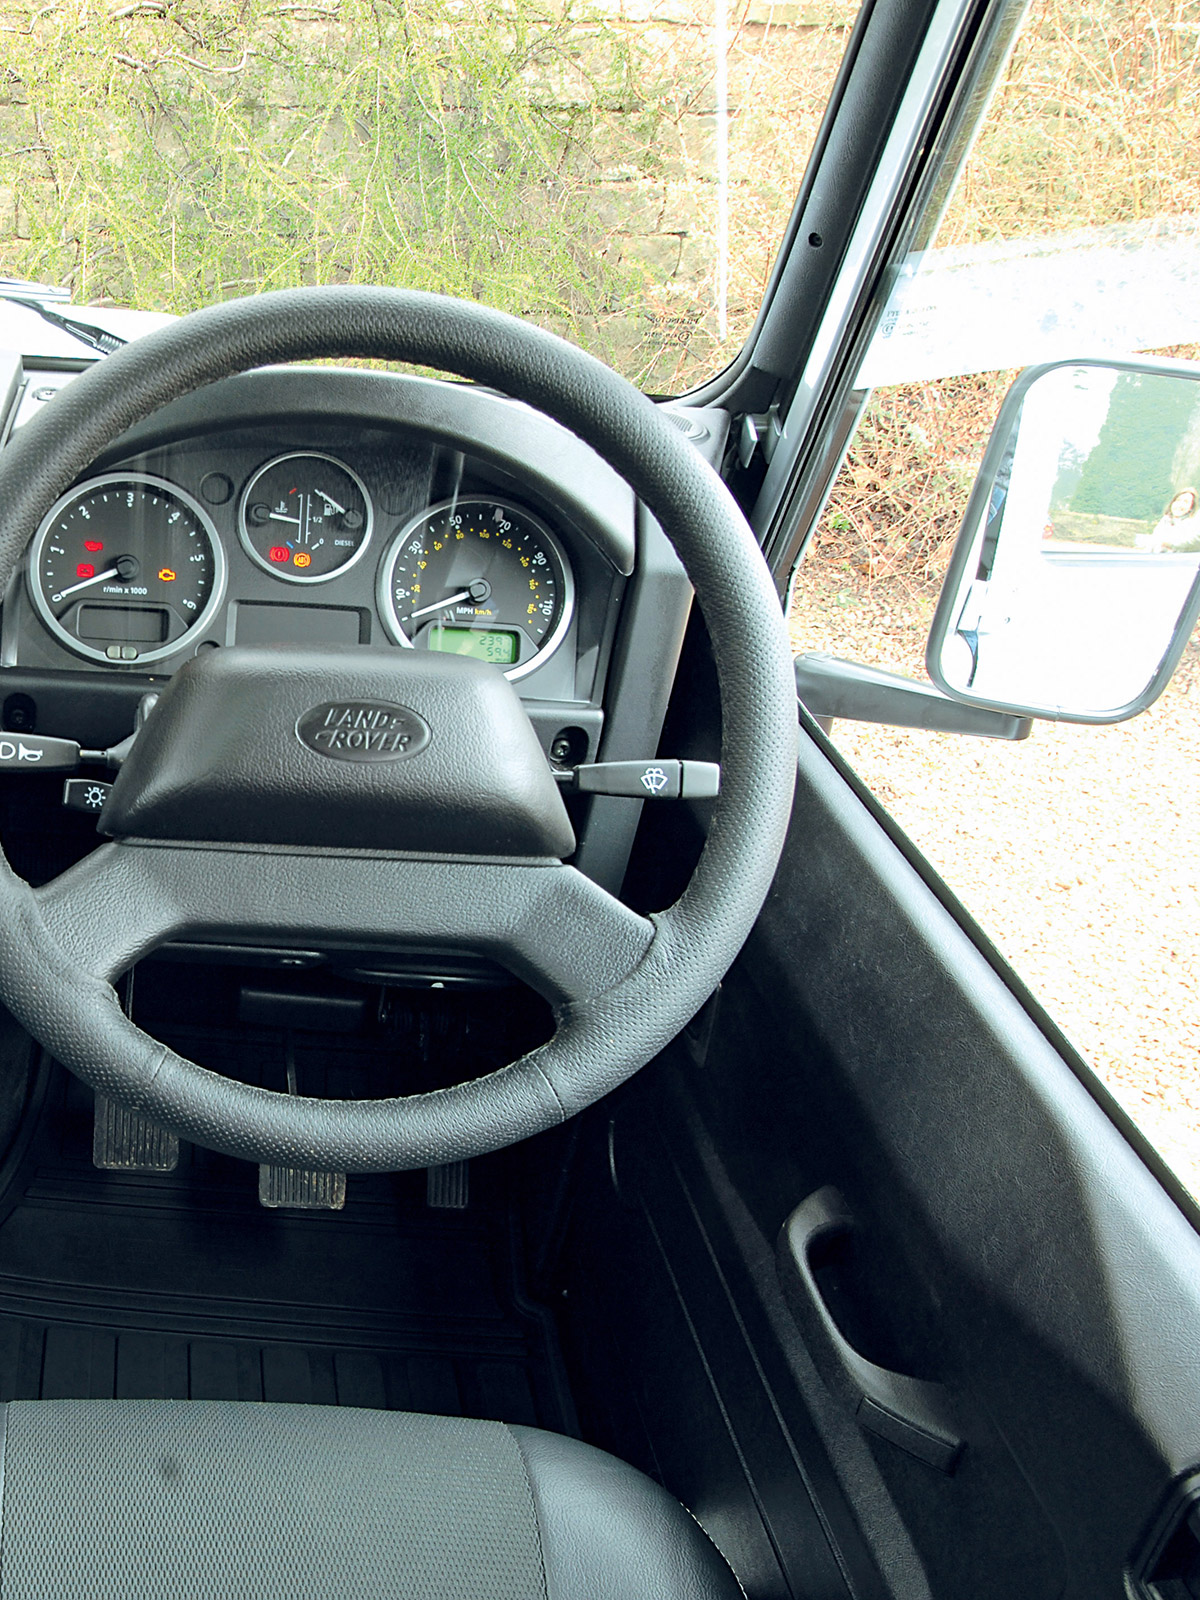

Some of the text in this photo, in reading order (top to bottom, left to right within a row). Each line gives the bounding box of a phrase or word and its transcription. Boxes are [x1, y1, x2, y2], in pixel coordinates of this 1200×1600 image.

[126, 493, 134, 502] 3
[78, 505, 87, 517] 2
[171, 511, 180, 521] 4
[449, 515, 462, 526] 50
[499, 519, 512, 531] 70
[408, 540, 422, 555] 30
[194, 554, 204, 562] 5
[534, 552, 547, 566] 90
[103, 586, 123, 594] r/min
[131, 587, 148, 595] 1000
[396, 588, 406, 600] 10
[186, 602, 197, 610] 6
[456, 606, 492, 616] MPH km/h
[542, 600, 554, 616] 110
[324, 708, 391, 729] LAND
[328, 729, 411, 752] ROVER
